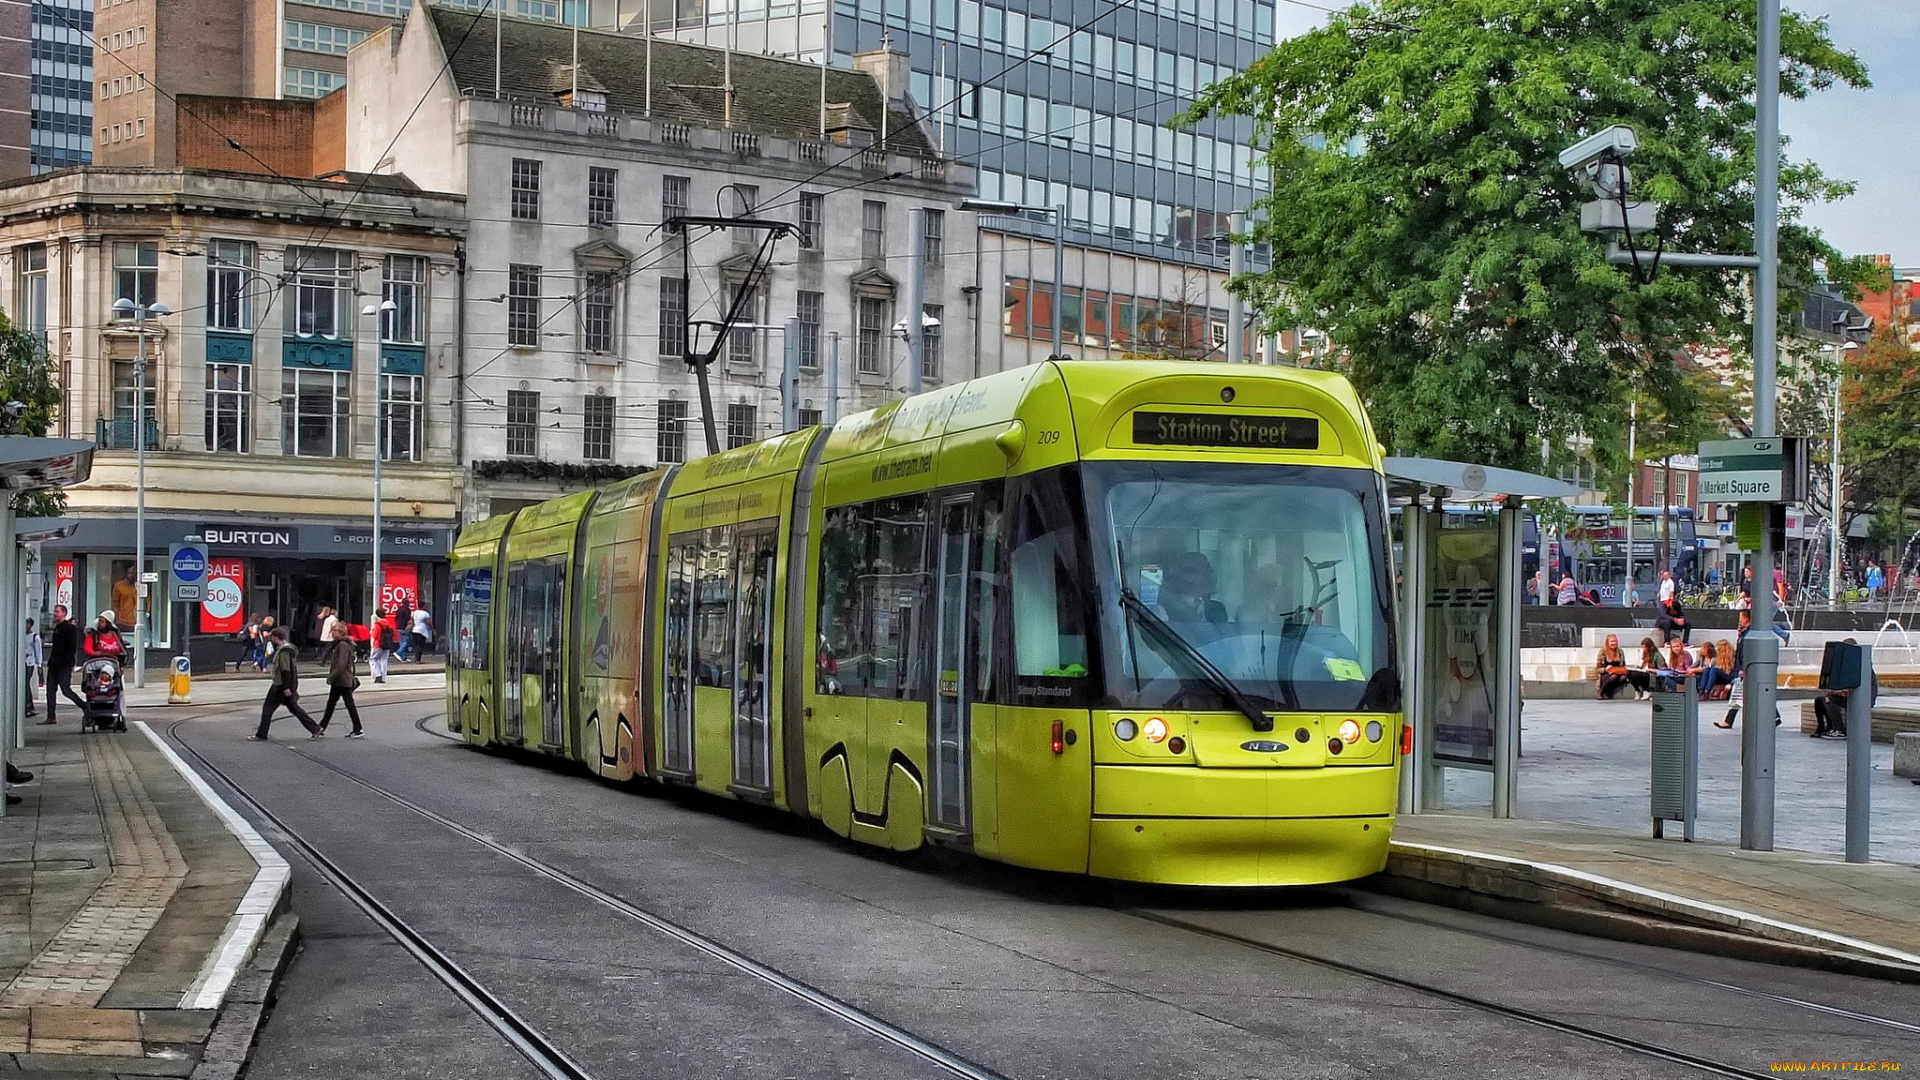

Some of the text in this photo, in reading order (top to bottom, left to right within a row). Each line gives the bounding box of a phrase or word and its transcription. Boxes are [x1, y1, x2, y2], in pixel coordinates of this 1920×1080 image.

[1157, 415, 1288, 443] Station Street
[1037, 430, 1060, 444] 209
[872, 451, 933, 483] www.thetram.net
[1704, 480, 1729, 494] Market
[1730, 479, 1770, 496] Square
[204, 530, 290, 545] BURTON
[207, 564, 240, 576] SALE
[207, 589, 239, 602] 50%
[382, 587, 415, 603] 50%
[382, 602, 415, 614] SAE
[1037, 686, 1071, 697] Standard
